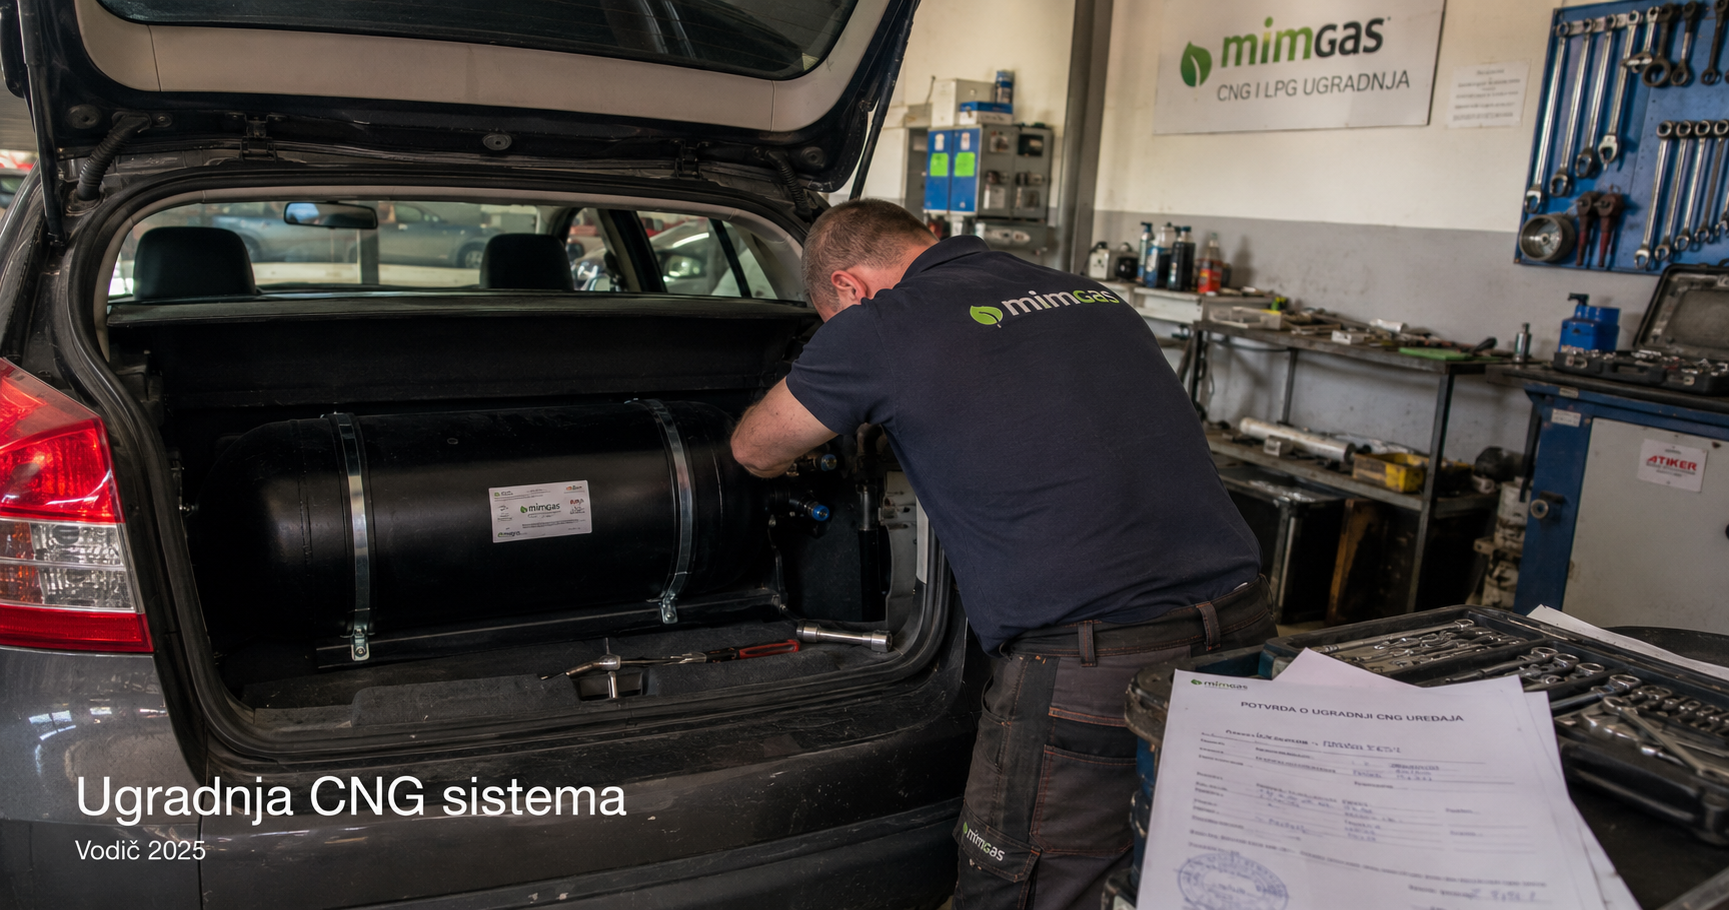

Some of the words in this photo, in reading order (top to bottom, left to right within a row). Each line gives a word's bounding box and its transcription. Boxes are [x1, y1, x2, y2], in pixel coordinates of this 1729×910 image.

[1217, 83, 1251, 101] CNG
[1255, 82, 1260, 98] I
[1264, 79, 1298, 98] LPG
[1303, 70, 1410, 95] UGRADNJA
[1647, 455, 1697, 471] ATIKER
[1241, 701, 1297, 713] POTVRDA
[1312, 708, 1373, 719] UGRADNJI
[1376, 713, 1403, 721] CNG
